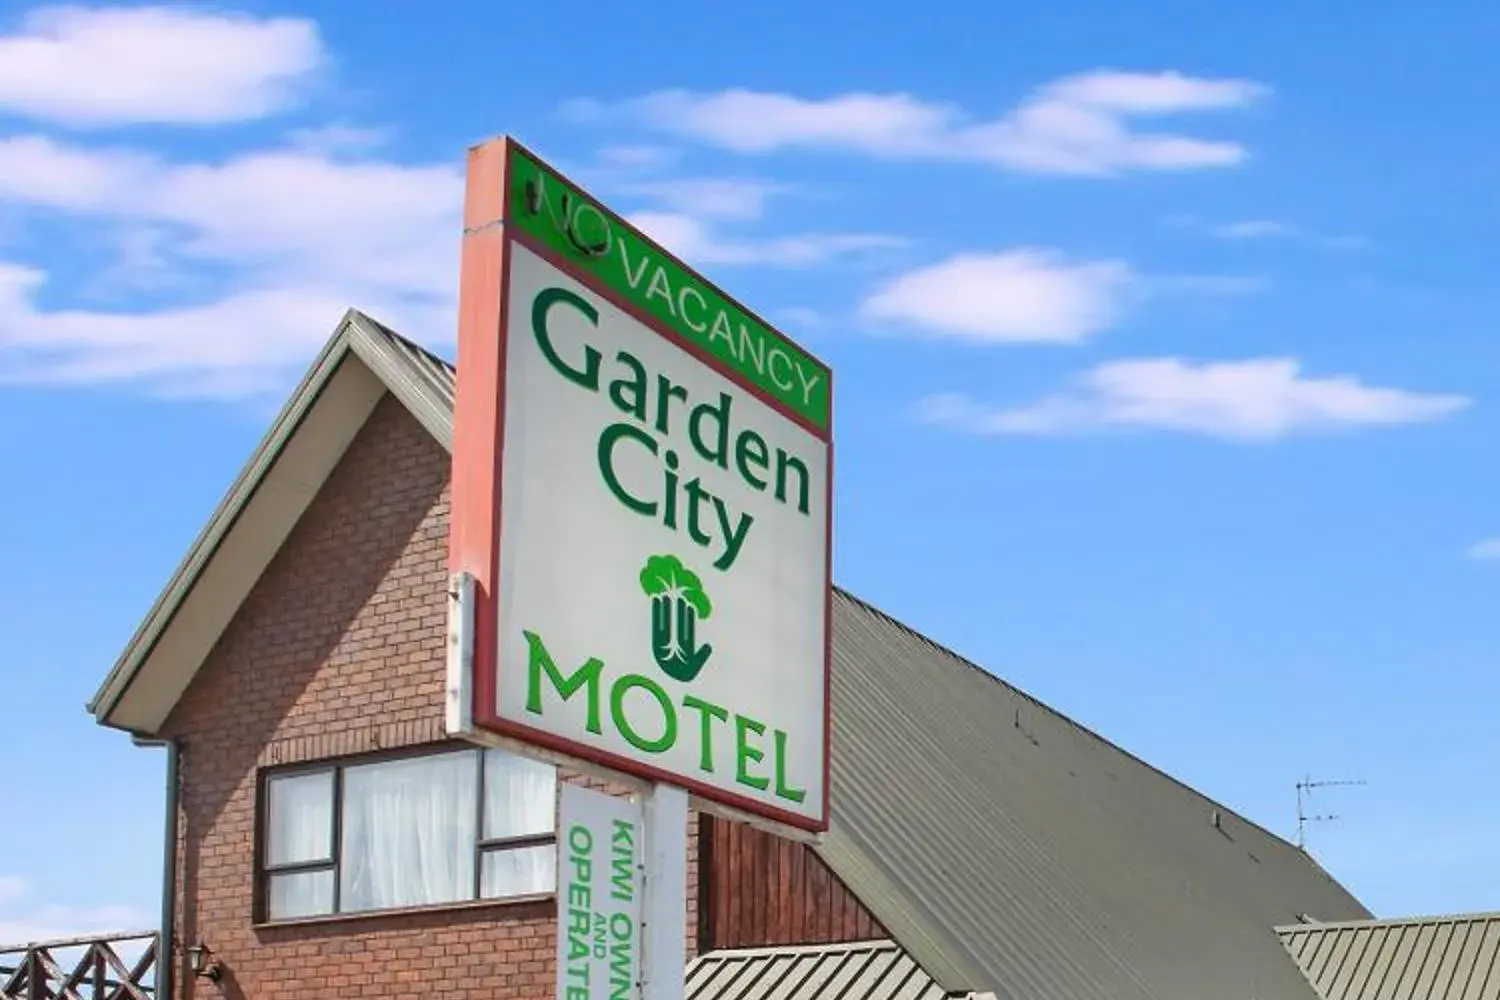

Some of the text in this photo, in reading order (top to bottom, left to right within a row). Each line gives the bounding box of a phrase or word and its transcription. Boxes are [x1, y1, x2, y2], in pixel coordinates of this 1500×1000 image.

[526, 172, 820, 407] NO VACANCY
[531, 287, 810, 515] Garden
[597, 422, 754, 572] City
[522, 629, 807, 803] MOTEL
[592, 911, 607, 960] AND
[611, 819, 634, 902] KIWI
